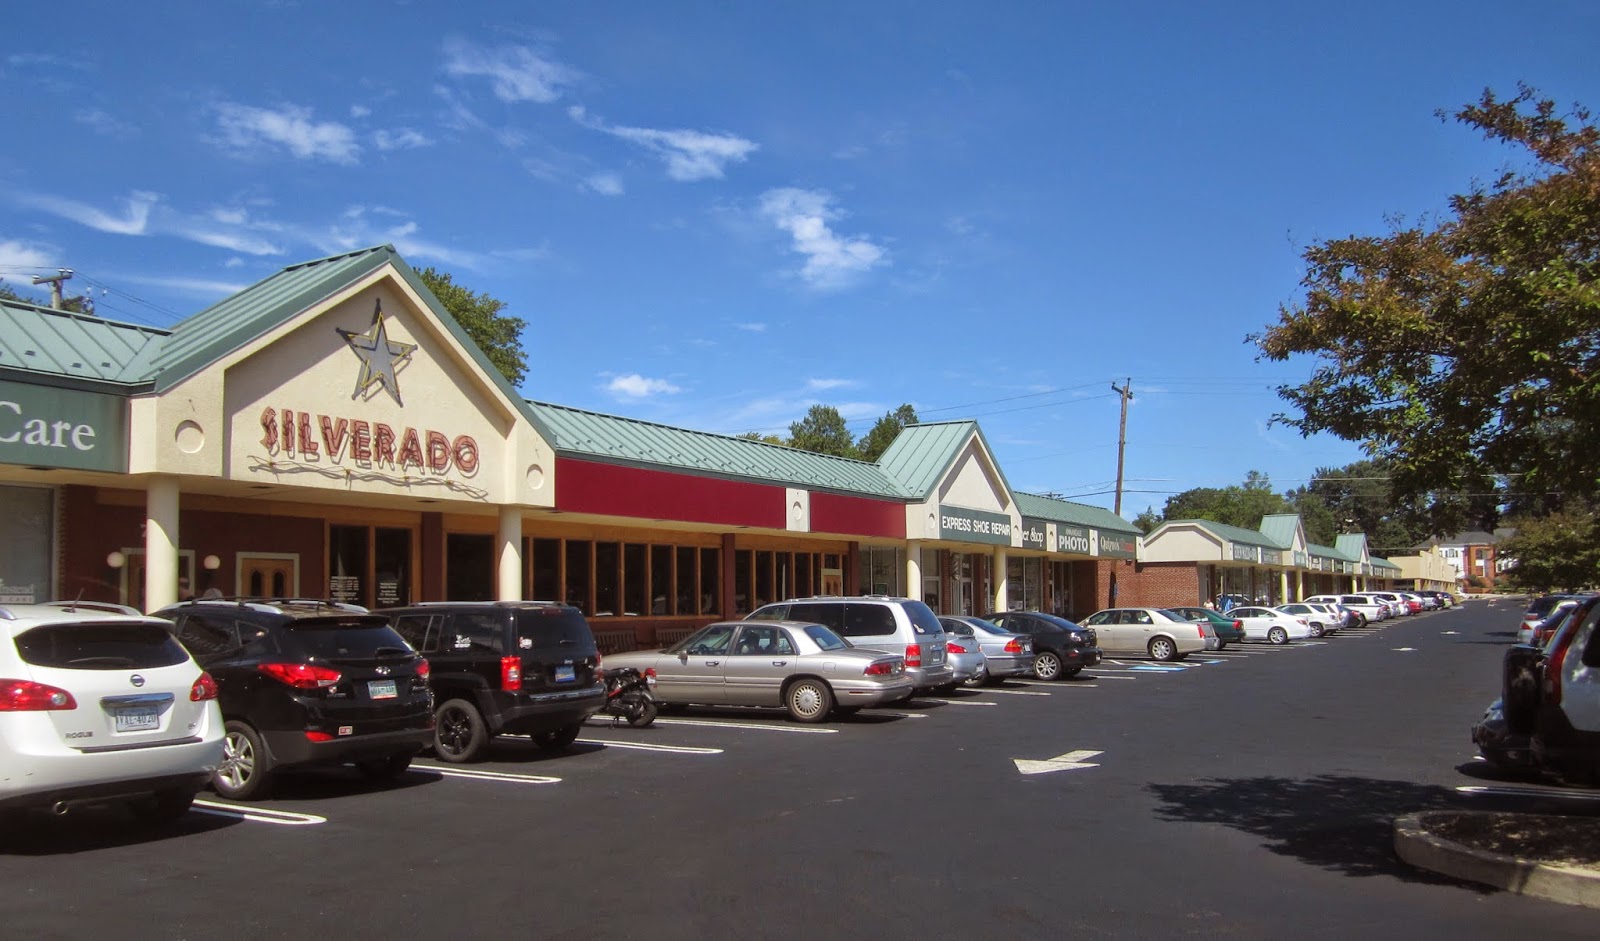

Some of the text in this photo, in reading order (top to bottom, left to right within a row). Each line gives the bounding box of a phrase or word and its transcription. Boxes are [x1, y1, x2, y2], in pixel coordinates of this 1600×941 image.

[0, 400, 96, 451] Care
[260, 406, 479, 475] SILVERADO
[942, 515, 1011, 536] EXPRESS SHOE REPAIR
[1030, 526, 1044, 547] Shop
[1058, 535, 1089, 552] PHOTO
[65, 731, 94, 739] ROGUE
